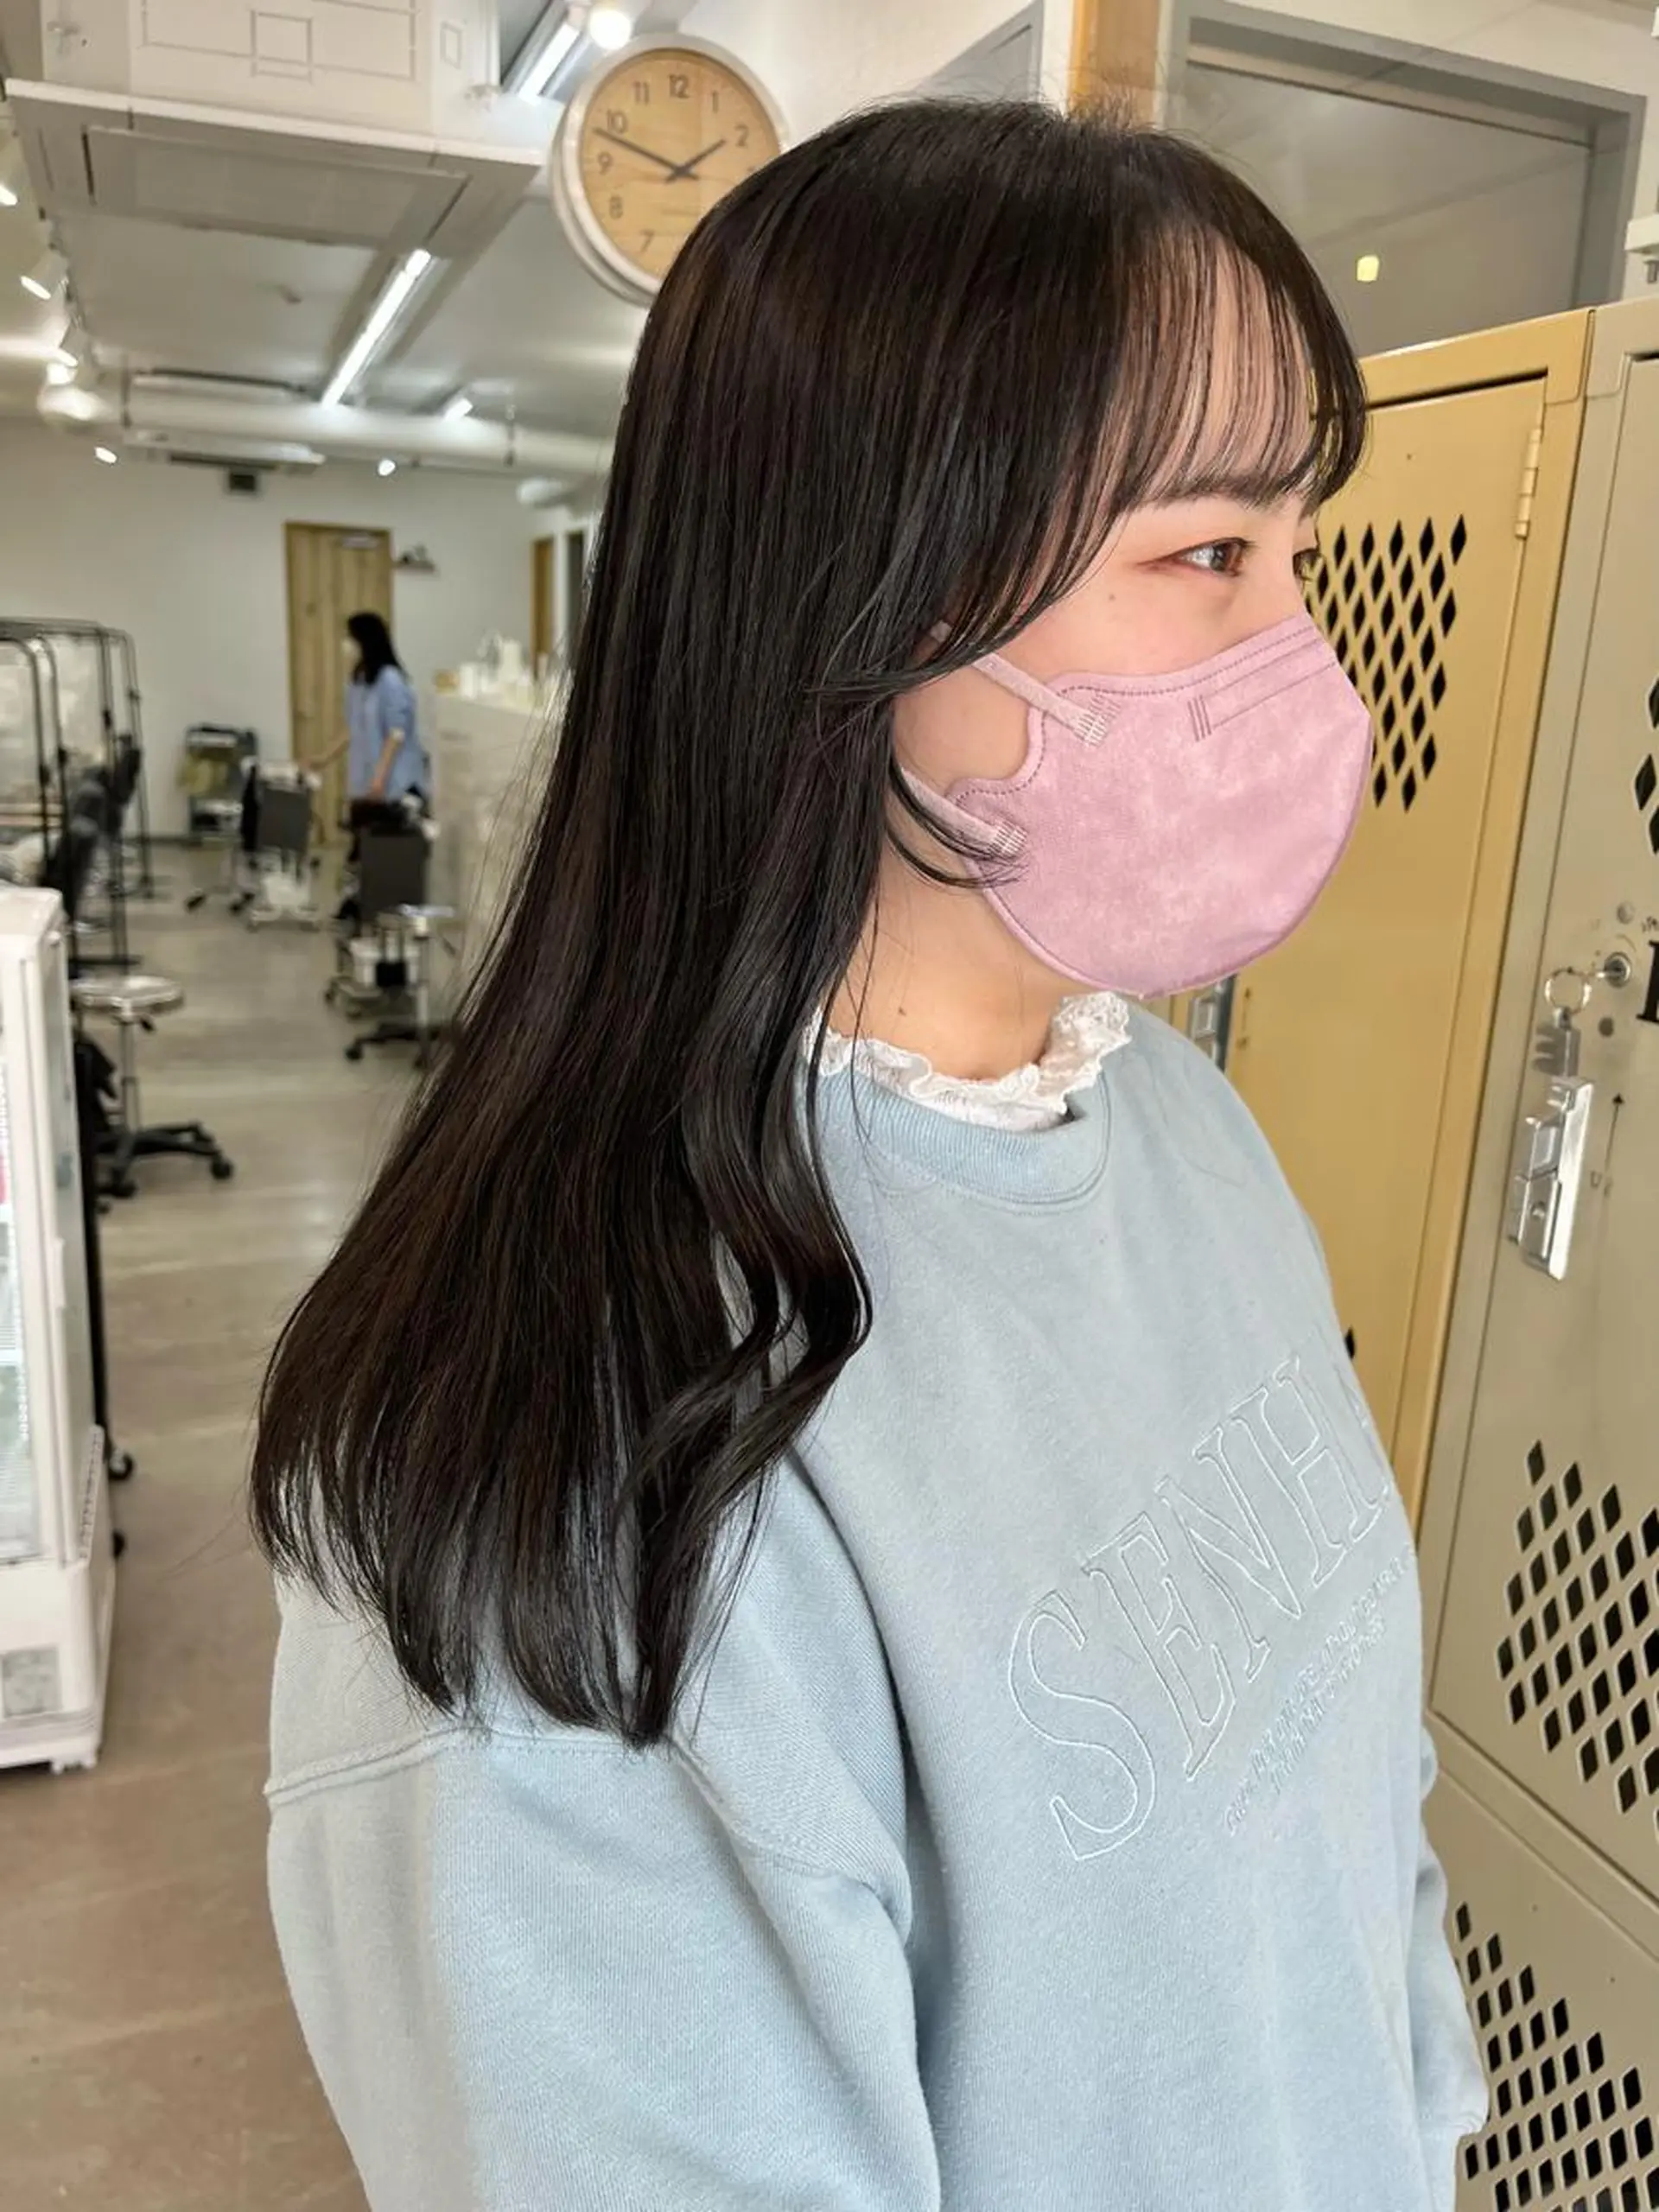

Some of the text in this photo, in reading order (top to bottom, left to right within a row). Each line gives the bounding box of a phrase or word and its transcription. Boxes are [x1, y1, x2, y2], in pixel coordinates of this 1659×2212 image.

[634, 81, 649, 105] 11
[669, 74, 690, 99] 12
[711, 90, 719, 113] 1
[607, 109, 627, 133] 10
[734, 124, 749, 147] 2
[598, 151, 613, 175] 9
[609, 196, 623, 219] 8
[639, 229, 654, 251] 7
[1007, 1355, 1389, 1860] SENH
